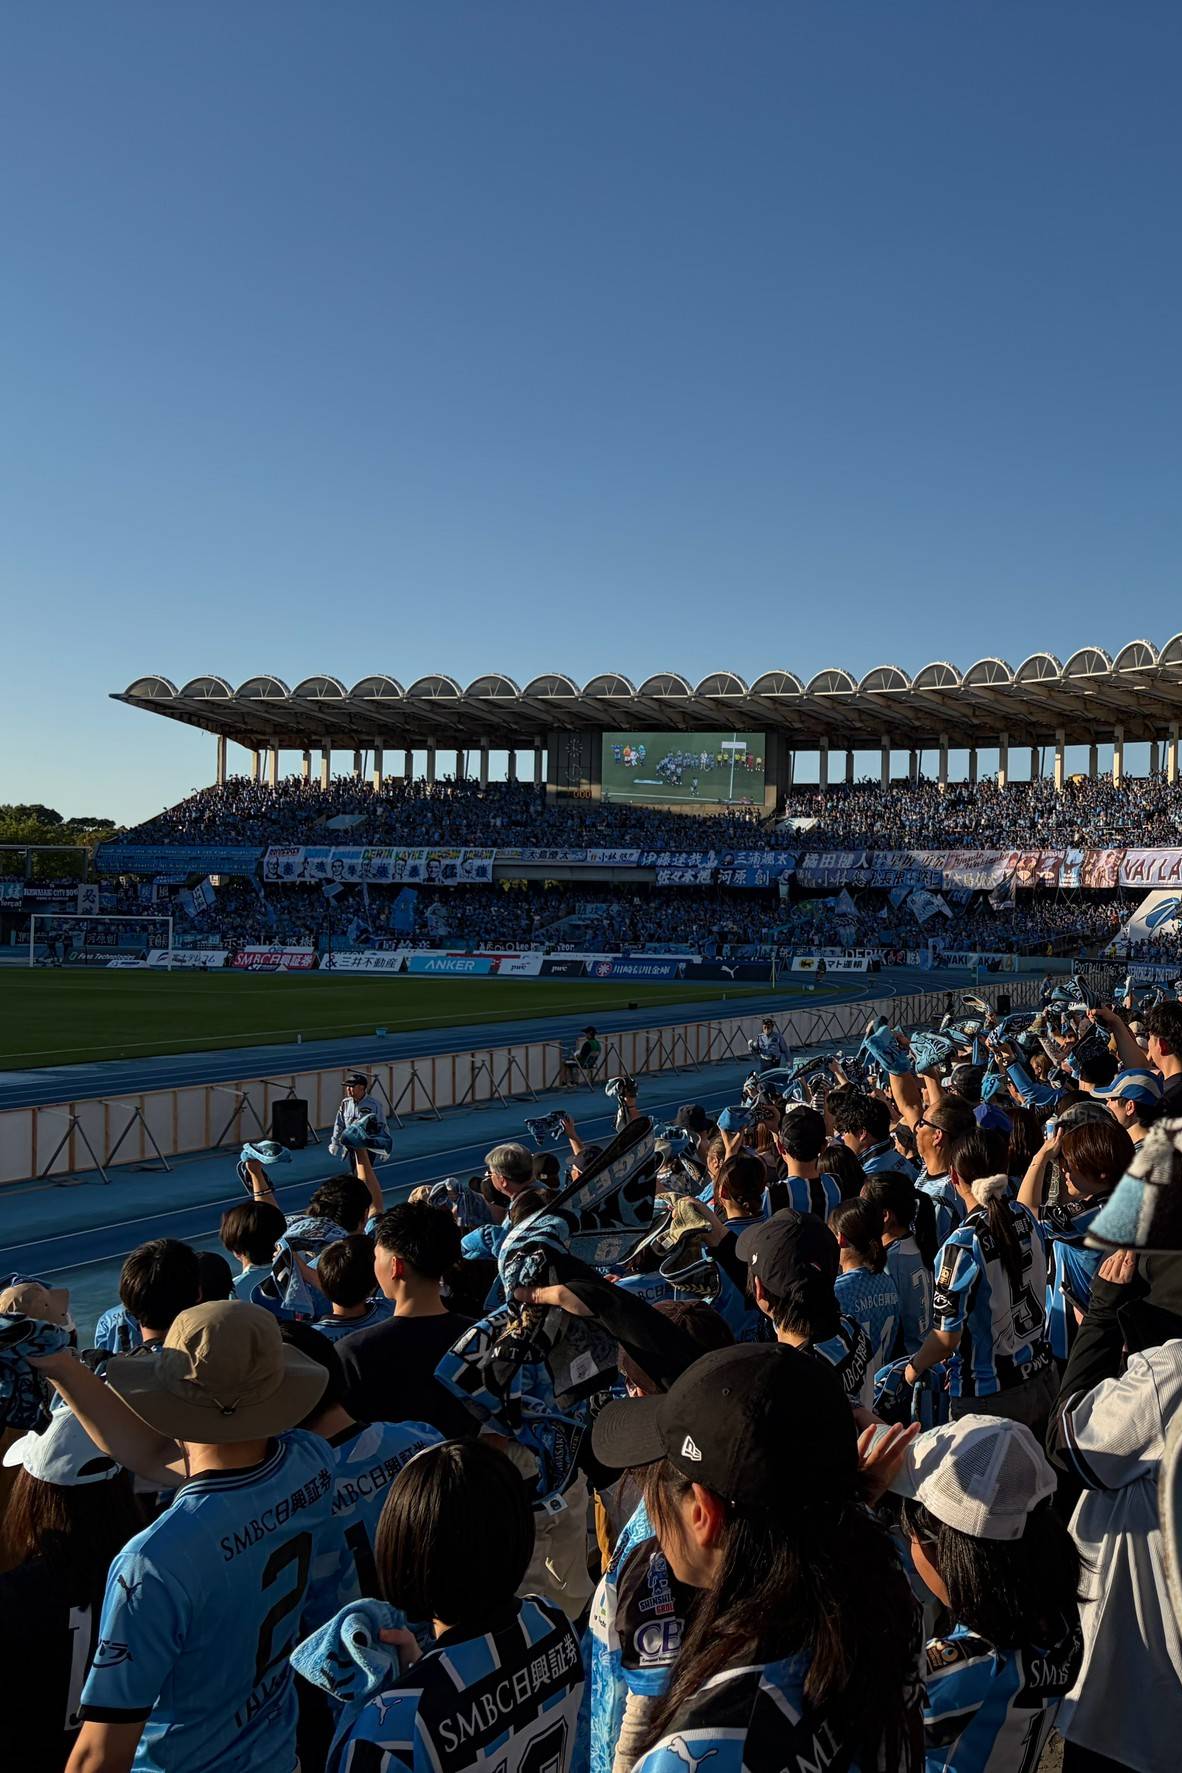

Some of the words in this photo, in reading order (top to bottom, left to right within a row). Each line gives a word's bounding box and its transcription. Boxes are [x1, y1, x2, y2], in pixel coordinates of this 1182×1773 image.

[1124, 858, 1156, 881] VAI
[339, 956, 397, 969] 三井不動産
[425, 959, 476, 971] ANKER
[823, 959, 863, 969] マト運輸
[219, 1469, 335, 1562] SMBC日興証券
[438, 1633, 578, 1753] SMBC日興証券
